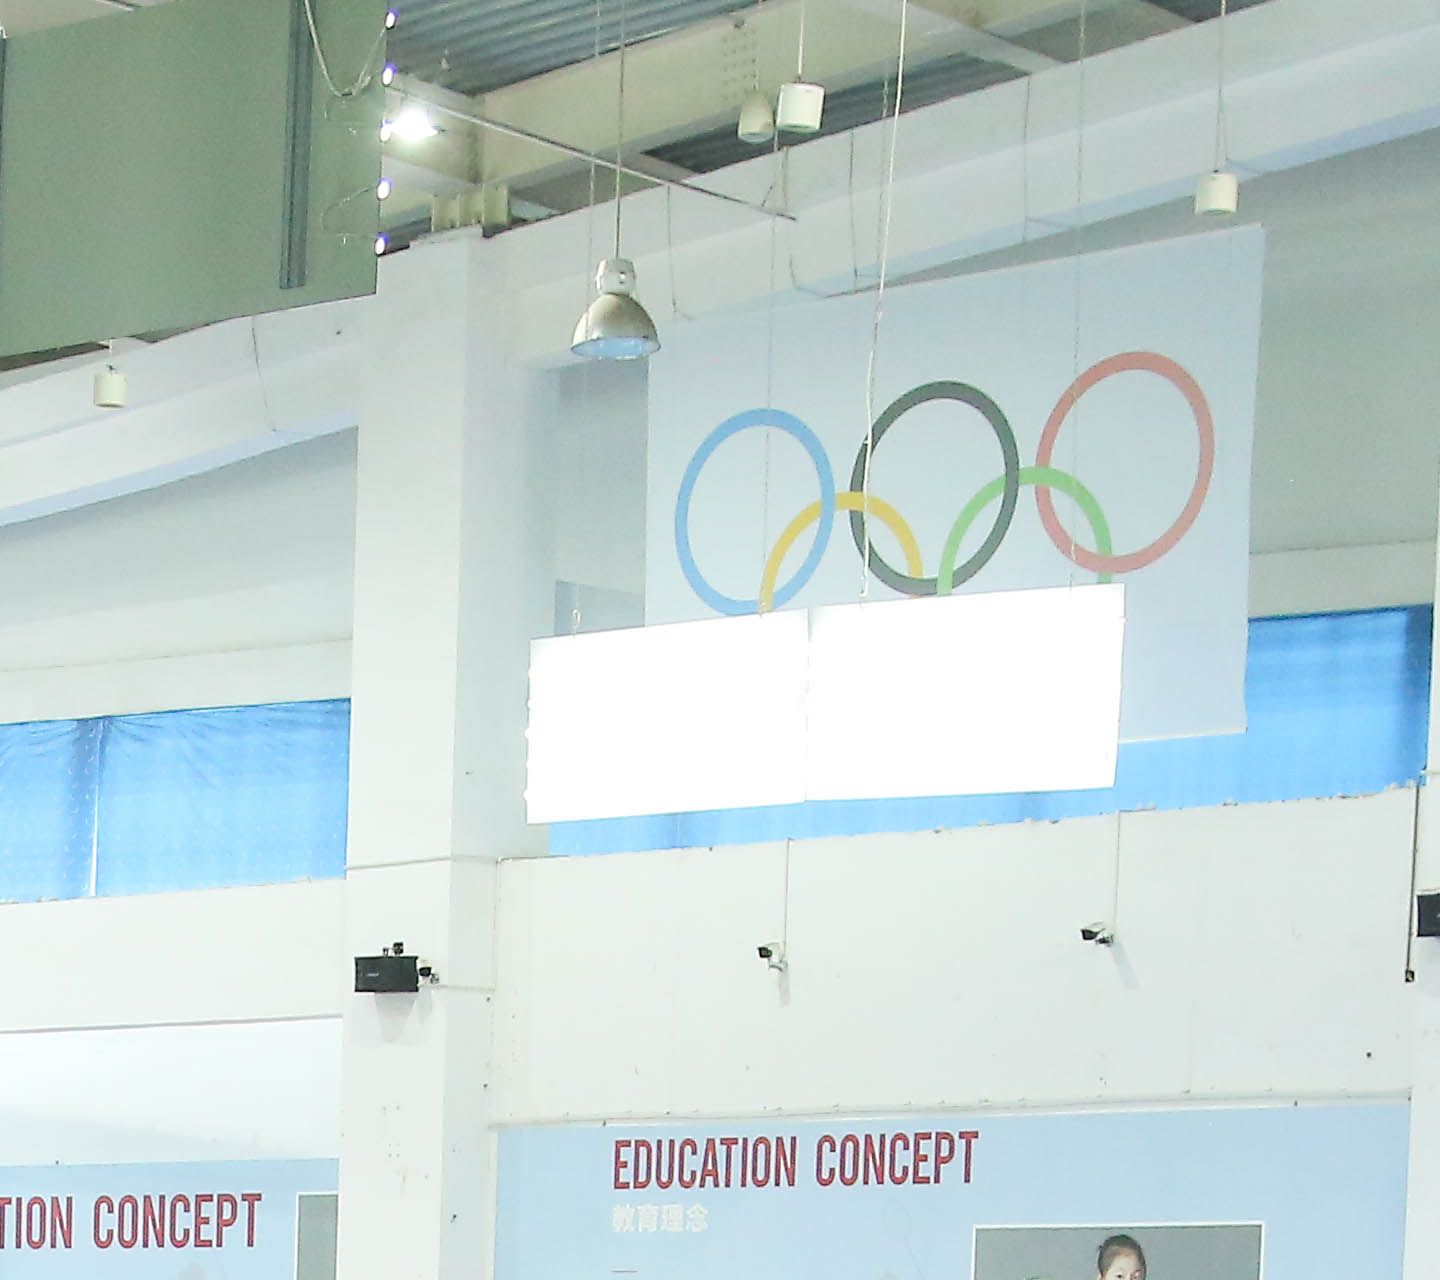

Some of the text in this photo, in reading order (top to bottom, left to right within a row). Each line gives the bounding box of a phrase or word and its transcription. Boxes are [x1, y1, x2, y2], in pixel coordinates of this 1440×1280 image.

[614, 1131, 979, 1189] EDUCATION CONCEPT
[94, 1193, 262, 1248] CONCEPT
[612, 1203, 709, 1232] 教育理念
